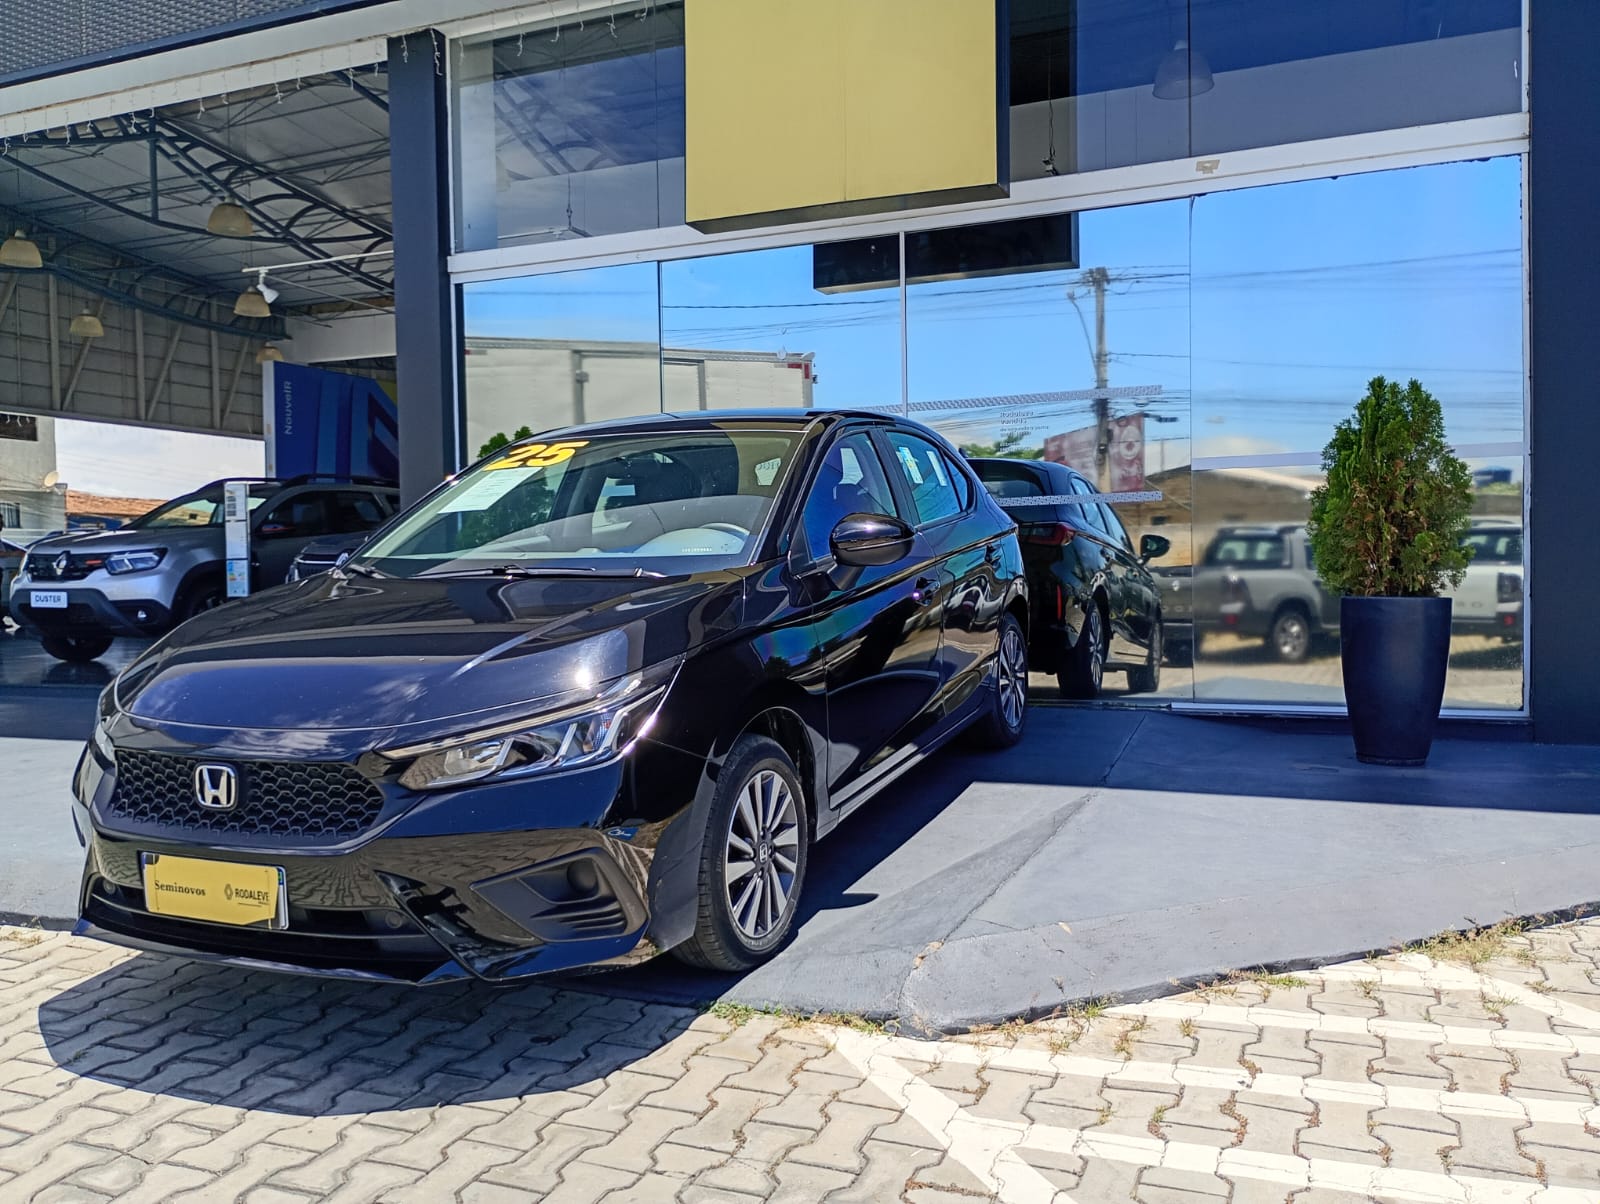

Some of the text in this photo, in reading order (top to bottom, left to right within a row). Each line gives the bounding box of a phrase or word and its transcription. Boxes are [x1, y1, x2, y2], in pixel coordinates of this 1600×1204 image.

[481, 440, 591, 471] 25
[34, 594, 62, 603] DUSTER
[154, 879, 207, 897] Seminovos
